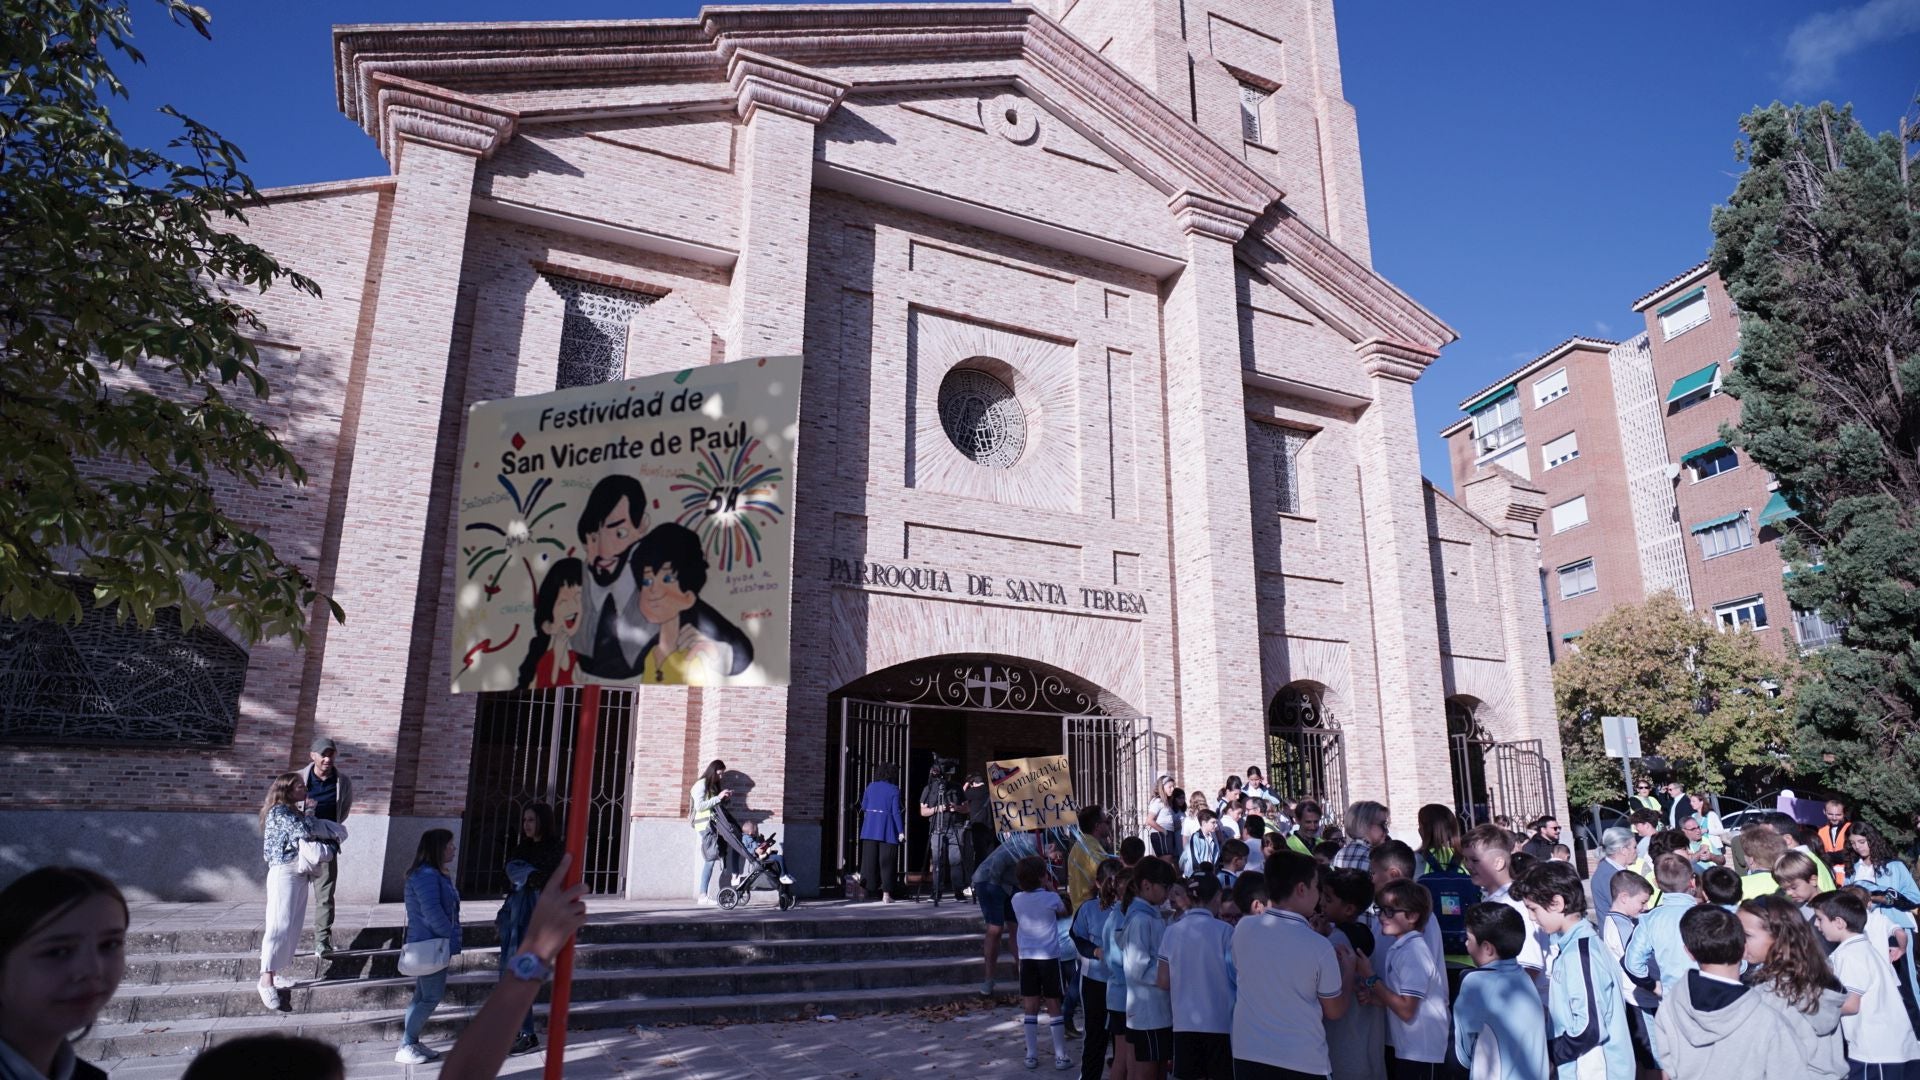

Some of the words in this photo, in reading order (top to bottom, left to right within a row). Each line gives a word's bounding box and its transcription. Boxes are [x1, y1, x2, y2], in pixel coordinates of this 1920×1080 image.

[539, 390, 666, 432] Festividad
[670, 387, 704, 412] de
[501, 451, 544, 475] San
[550, 435, 644, 469] Vicente
[651, 431, 683, 456] de
[690, 421, 747, 452] Paúl
[829, 557, 953, 593] PARROQUIA
[966, 573, 995, 597] DE
[1005, 577, 1067, 605] SANTA
[1079, 587, 1149, 614] TERESA
[1037, 776, 1058, 794] con
